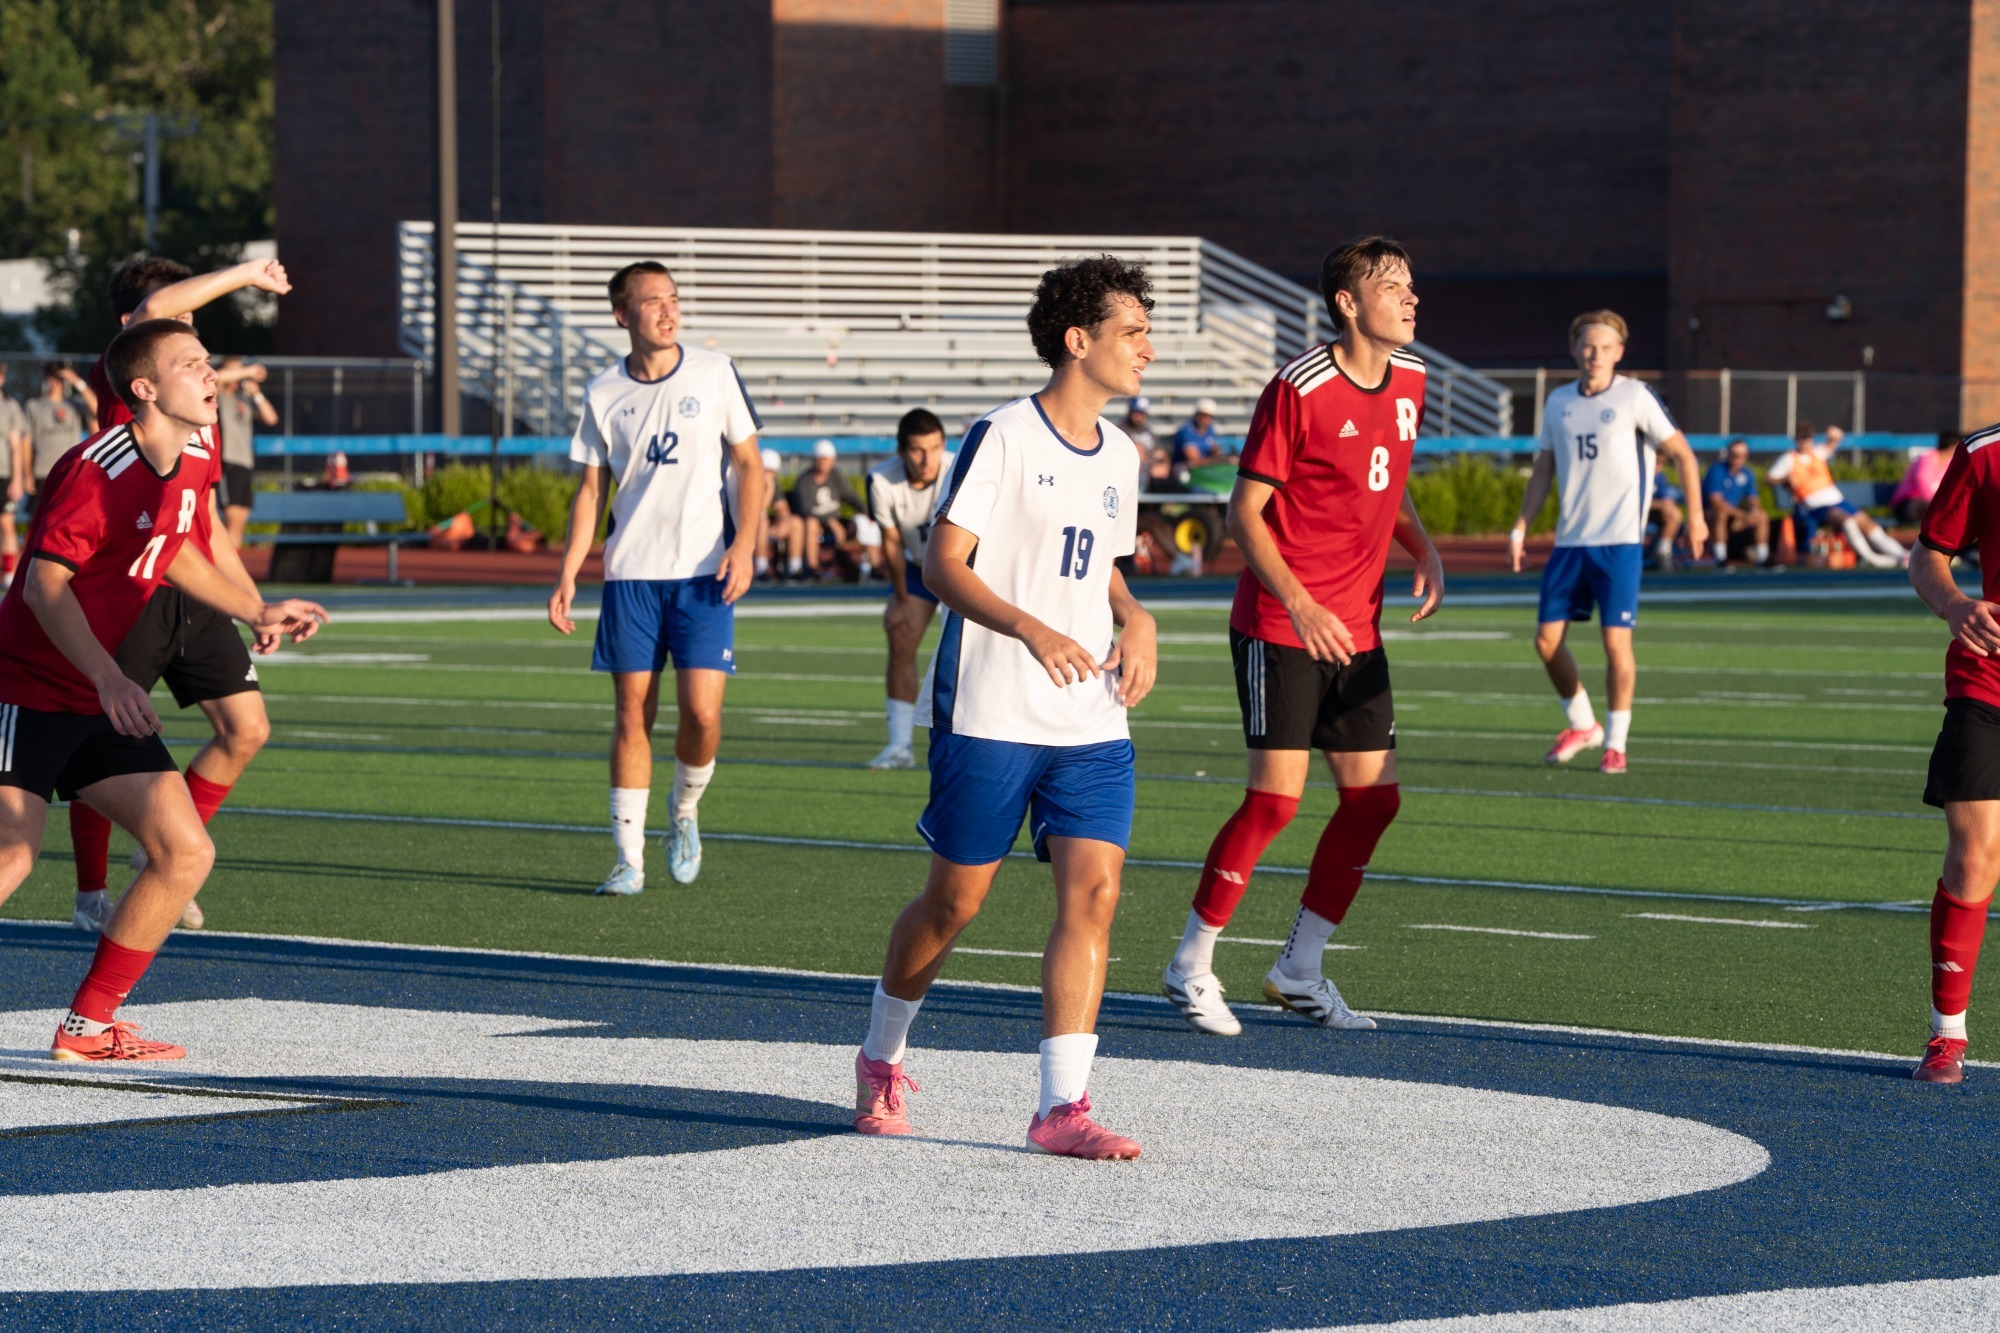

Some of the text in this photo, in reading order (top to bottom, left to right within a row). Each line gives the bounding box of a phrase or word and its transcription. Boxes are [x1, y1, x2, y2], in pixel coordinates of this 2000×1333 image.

[1396, 398, 1417, 442] R
[646, 431, 679, 467] 42
[1368, 446, 1390, 492] 8
[1576, 433, 1598, 461] 15
[1059, 526, 1095, 580] 19
